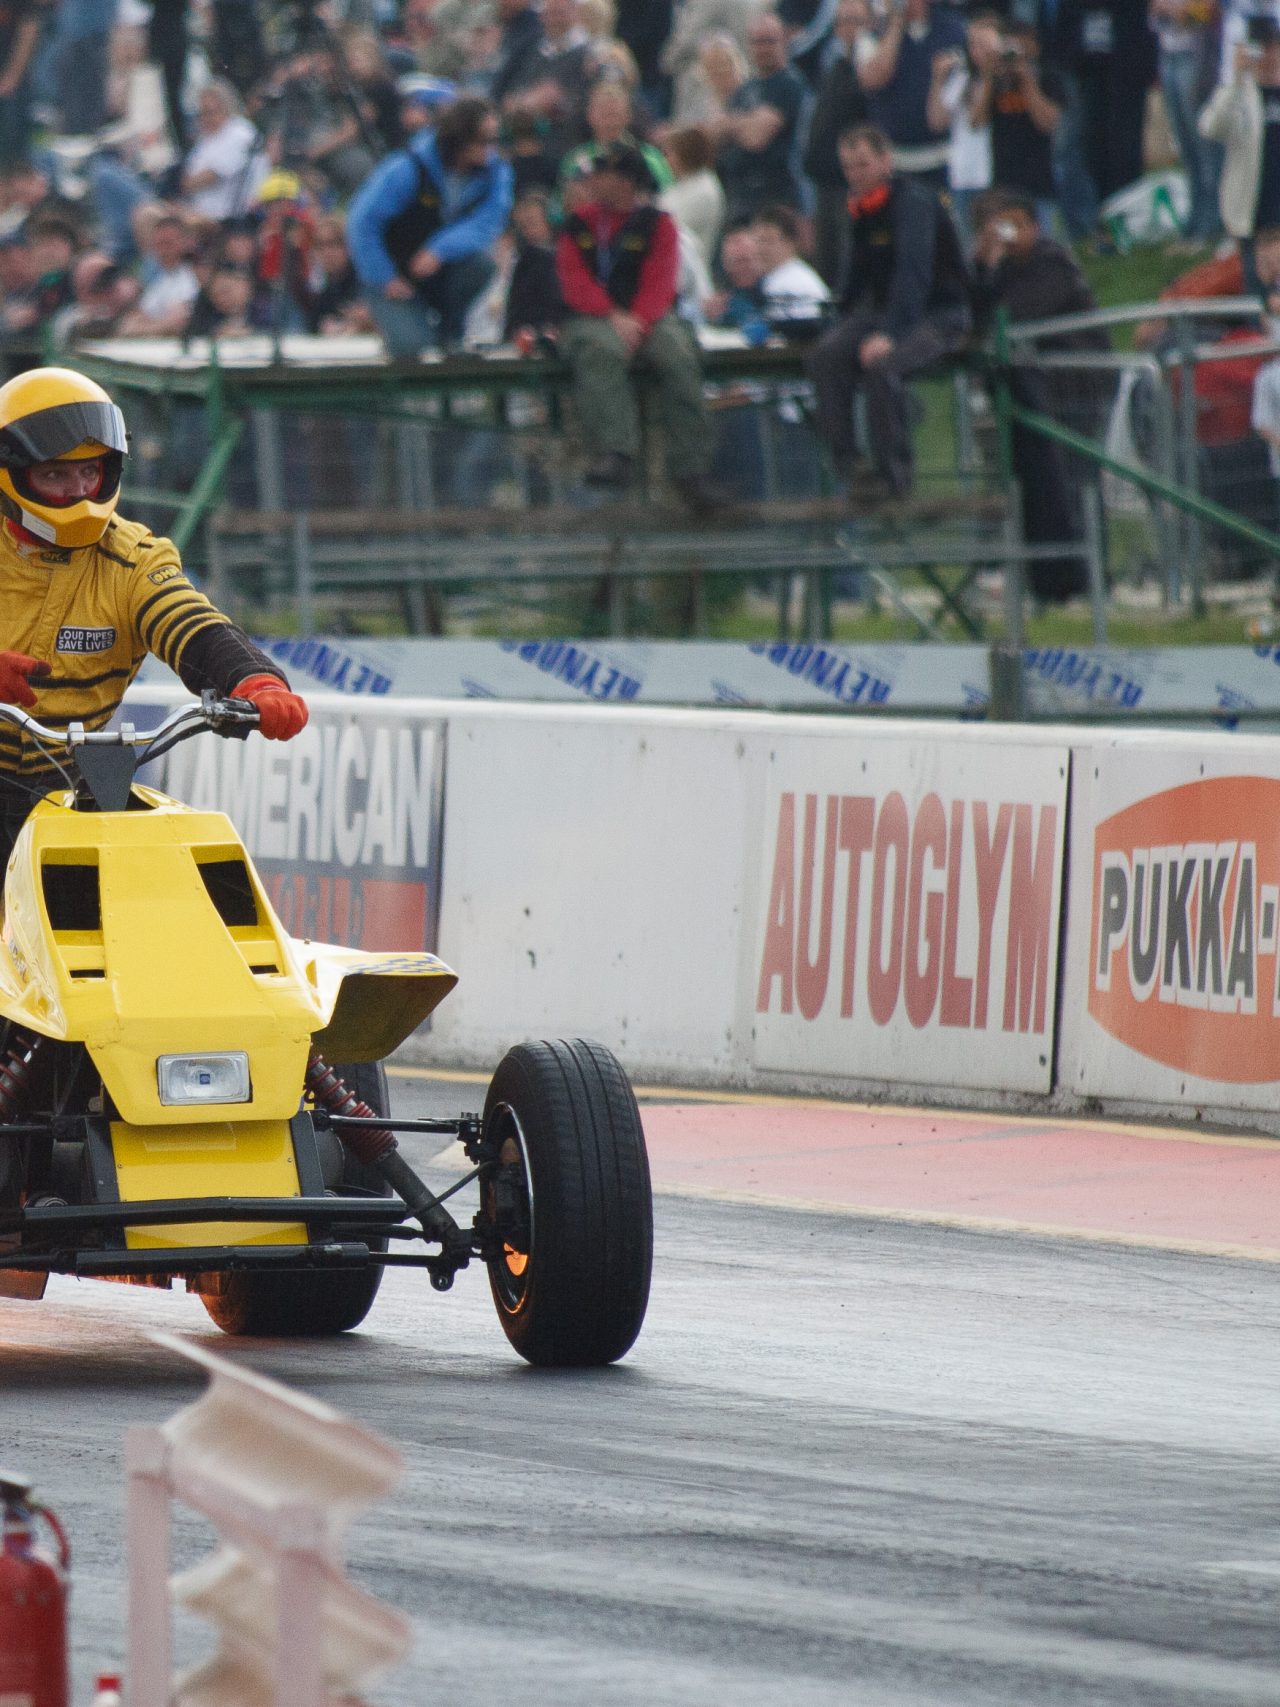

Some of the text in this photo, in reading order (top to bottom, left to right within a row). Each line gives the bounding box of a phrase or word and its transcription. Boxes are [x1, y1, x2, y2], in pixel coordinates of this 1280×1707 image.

[58, 640, 113, 650] SAVE LIVES
[59, 630, 114, 641] LOUD PIPES
[191, 726, 434, 868] AMERICAN
[261, 872, 365, 950] ORLD
[756, 790, 1057, 1034] AUTOGLYM
[1096, 842, 1280, 1015] PUKKA-
